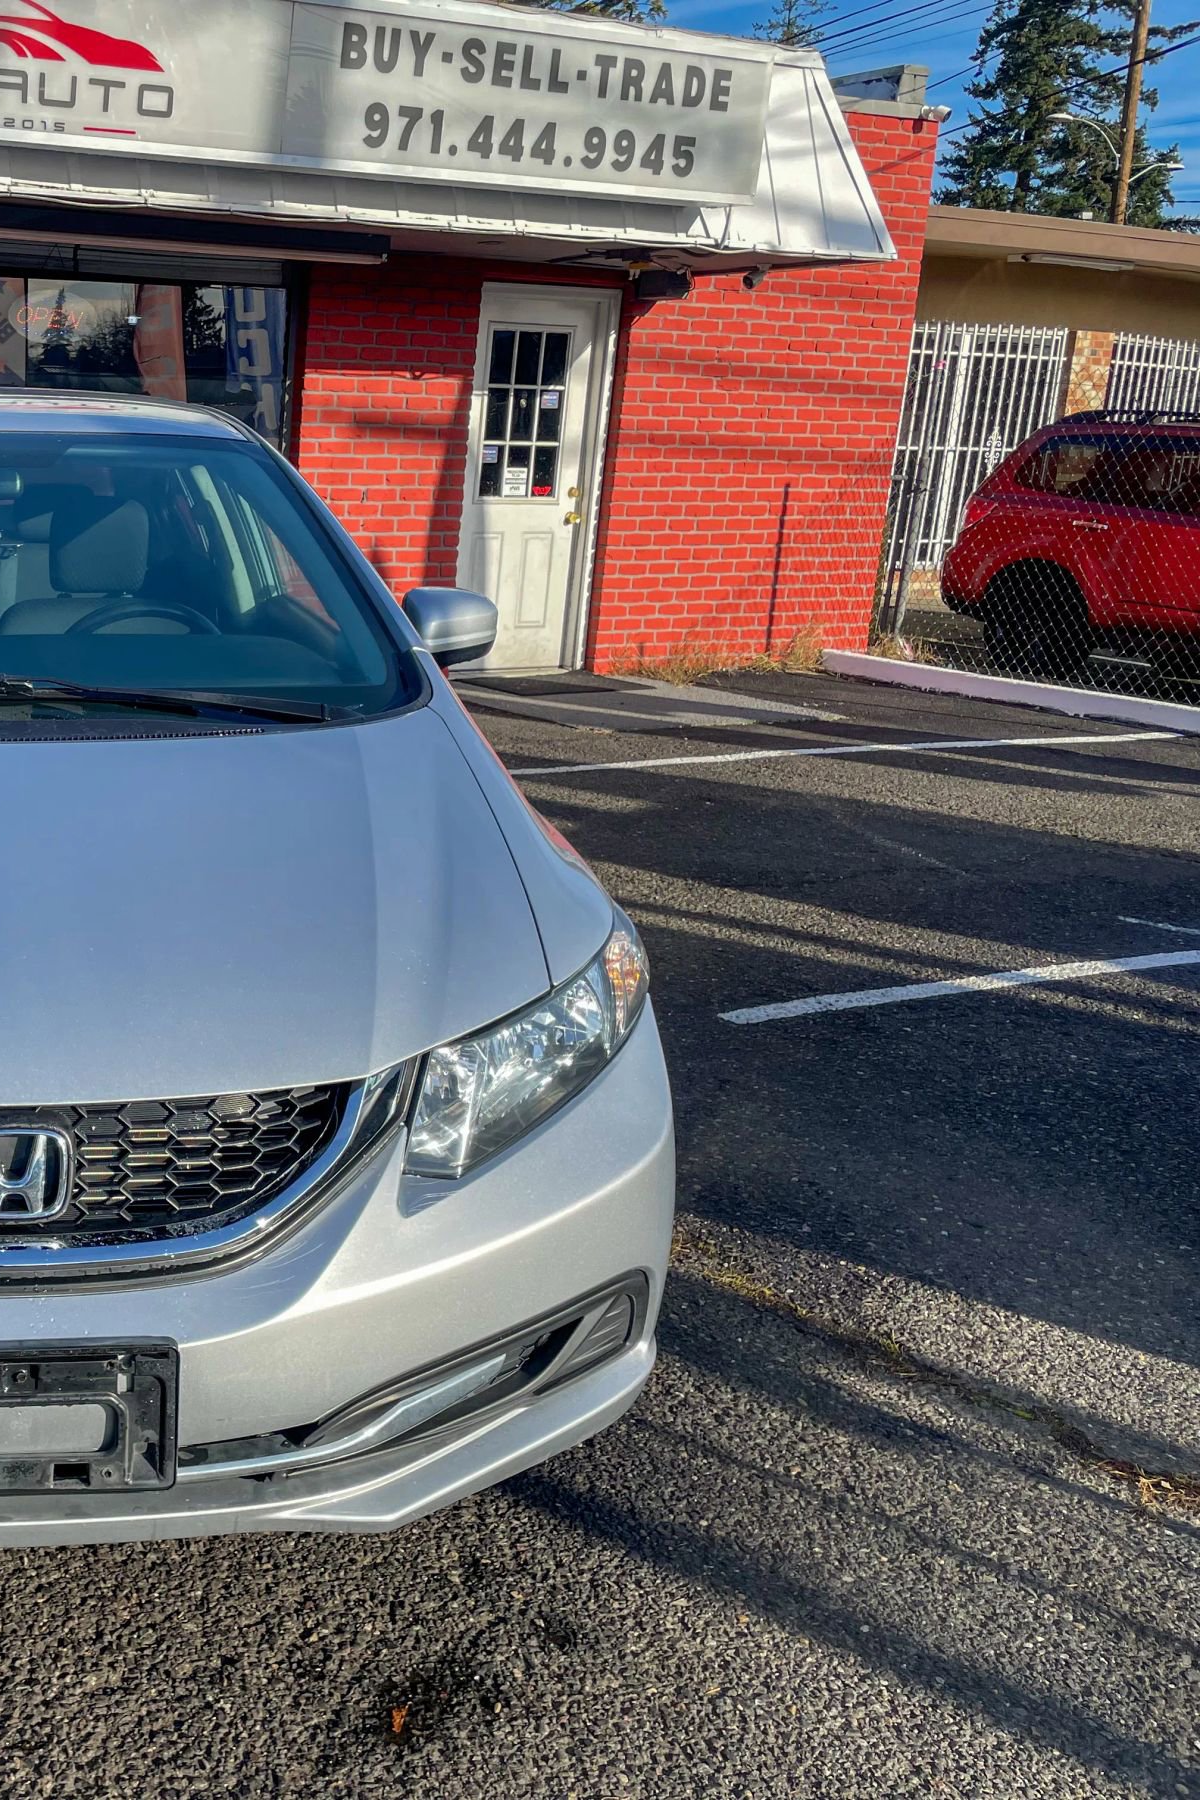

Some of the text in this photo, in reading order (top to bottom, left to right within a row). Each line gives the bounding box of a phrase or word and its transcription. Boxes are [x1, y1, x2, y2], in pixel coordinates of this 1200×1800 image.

[3, 117, 66, 133] 2015
[362, 101, 697, 178] 971.444.9945
[16, 305, 85, 329] OPEN
